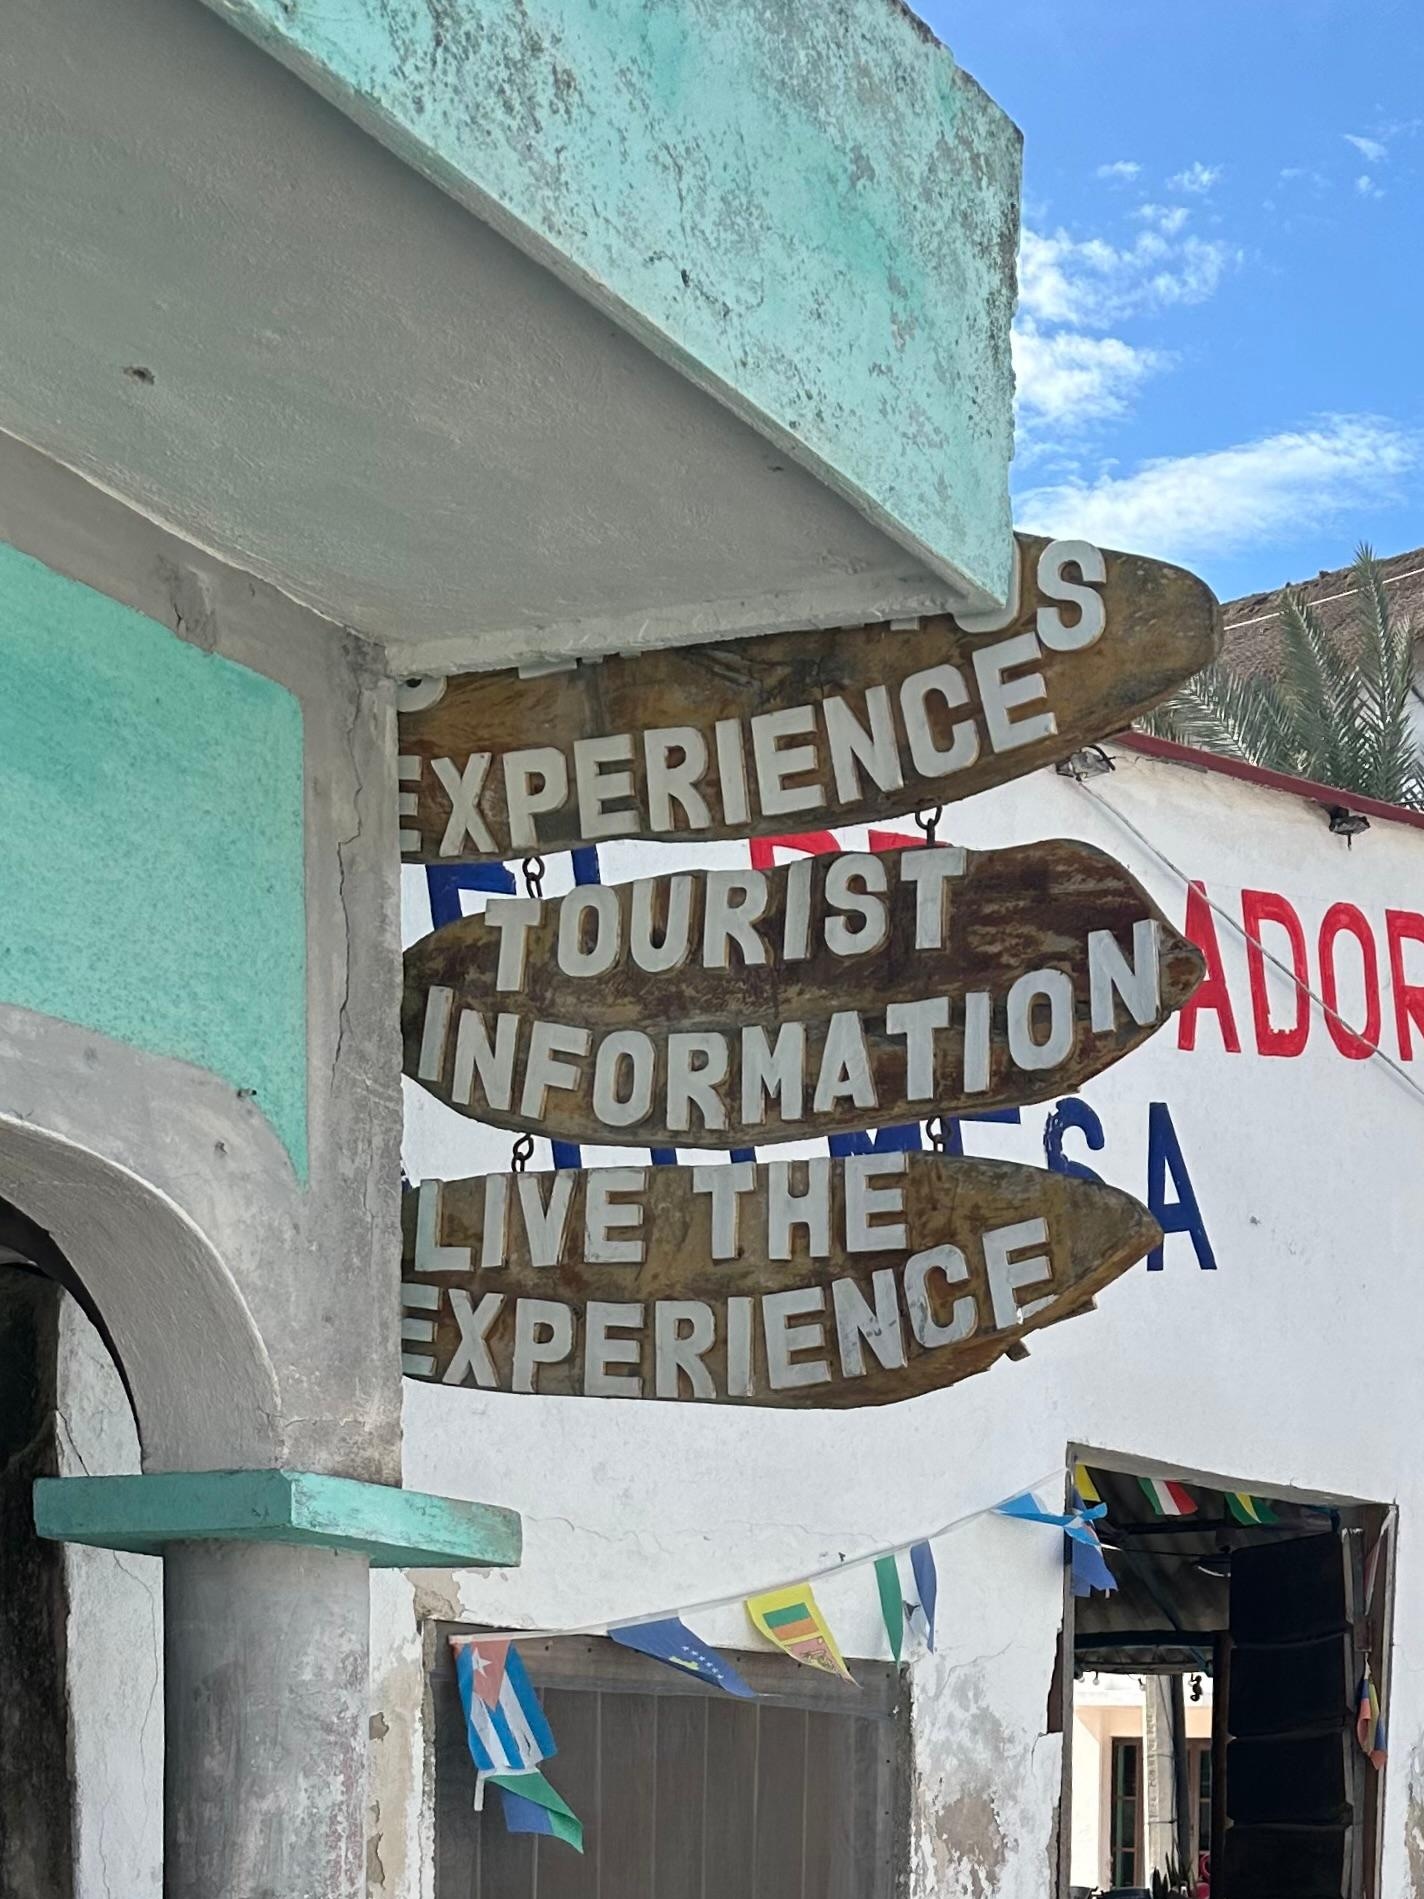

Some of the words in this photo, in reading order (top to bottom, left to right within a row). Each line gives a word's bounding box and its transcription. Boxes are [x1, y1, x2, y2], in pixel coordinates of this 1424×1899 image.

[484, 846, 966, 992] TOURIST
[418, 918, 1161, 1132] INFORMATION
[415, 1167, 647, 1273] LIVE
[692, 1150, 911, 1262] THE
[402, 1216, 1059, 1400] EXPERIENCE
